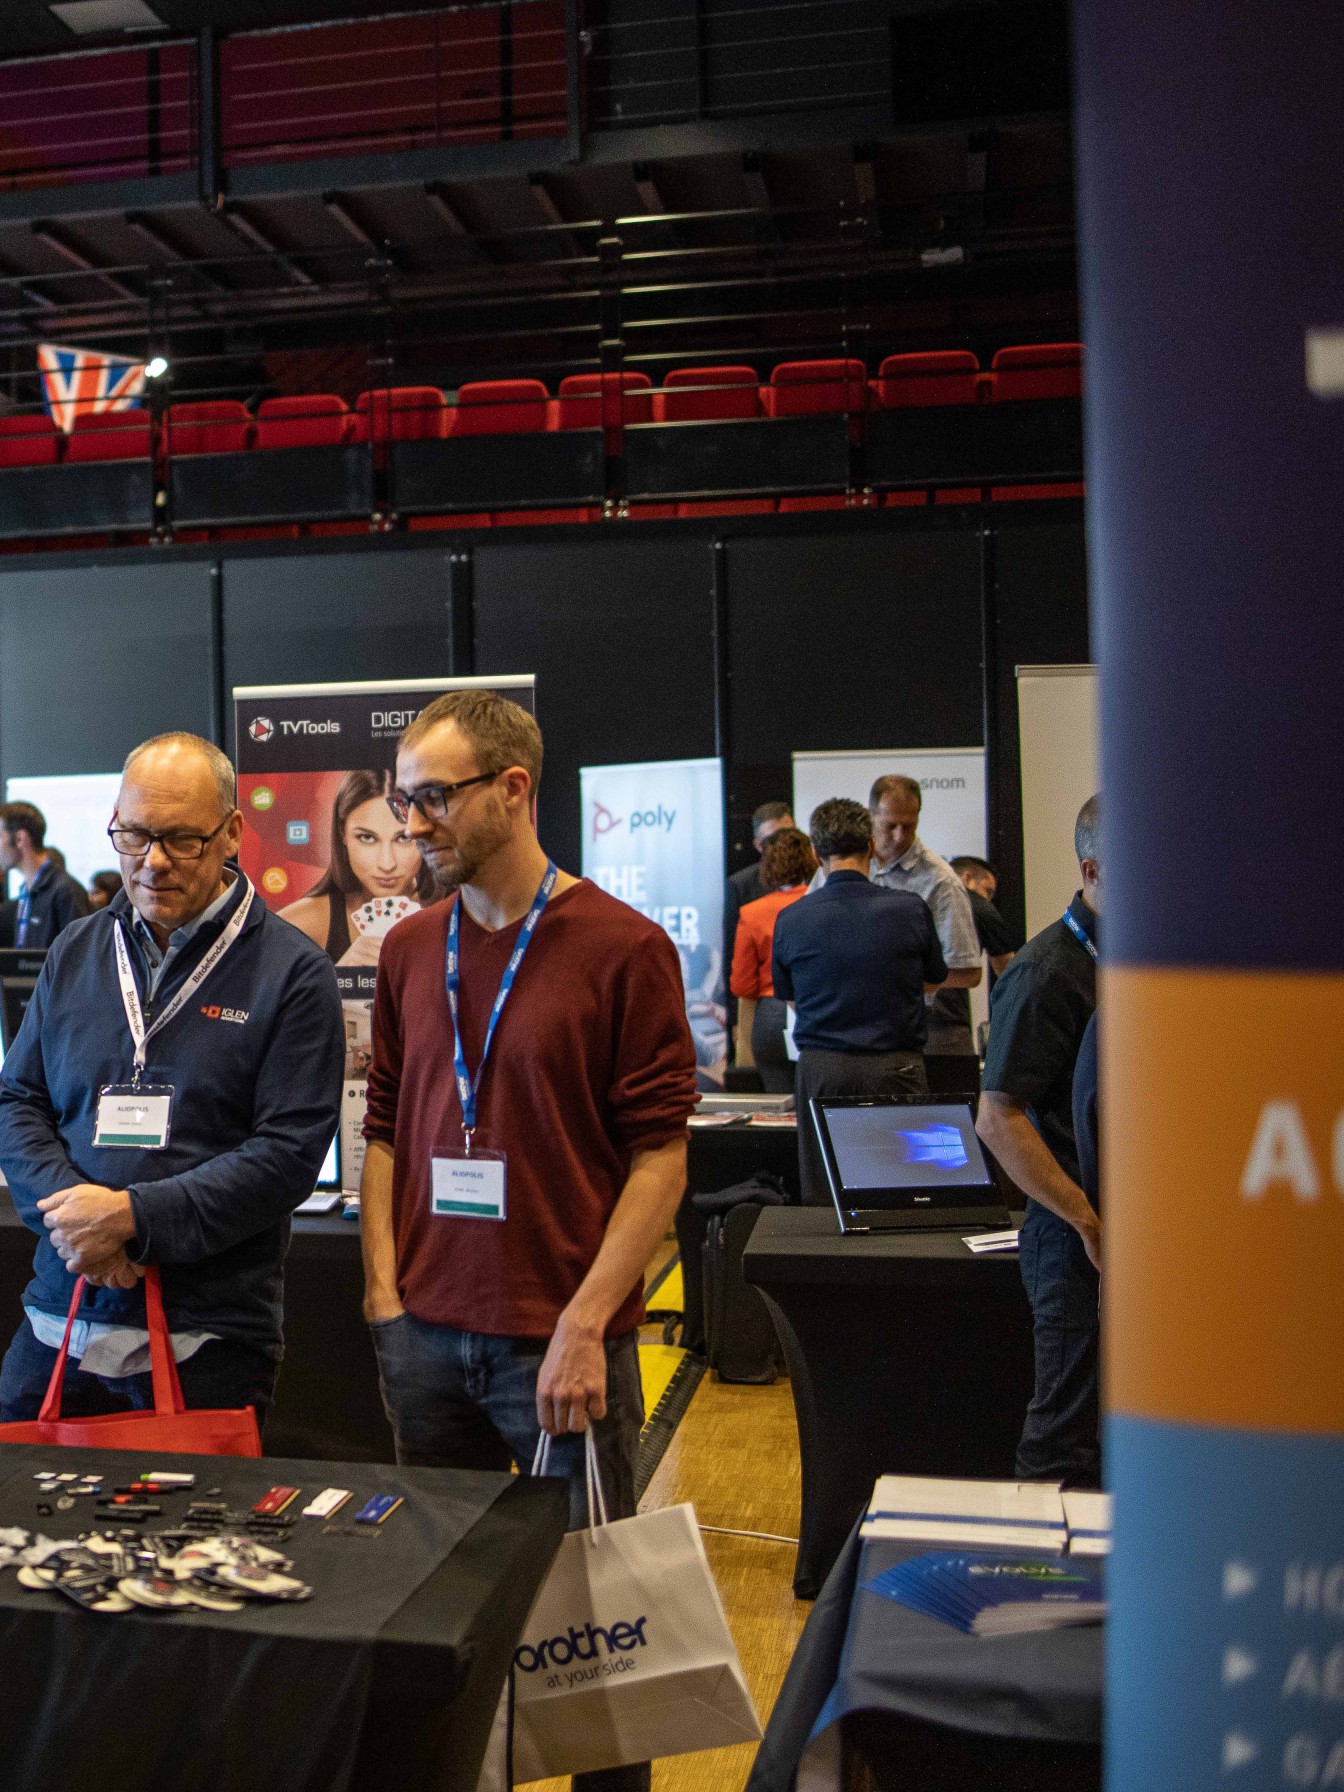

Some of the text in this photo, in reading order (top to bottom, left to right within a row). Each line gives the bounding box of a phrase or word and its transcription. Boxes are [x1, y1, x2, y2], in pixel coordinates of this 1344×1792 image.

[280, 719, 340, 735] TVTools
[920, 776, 966, 790] snom
[630, 804, 677, 834] poly
[592, 865, 647, 901] THE
[192, 939, 227, 984] Bitdefender
[358, 974, 377, 988] les
[126, 990, 141, 1036] Bitdefender
[221, 1007, 250, 1021] IGLEN
[1240, 1098, 1344, 1204] A
[546, 1654, 637, 1689] at your side
